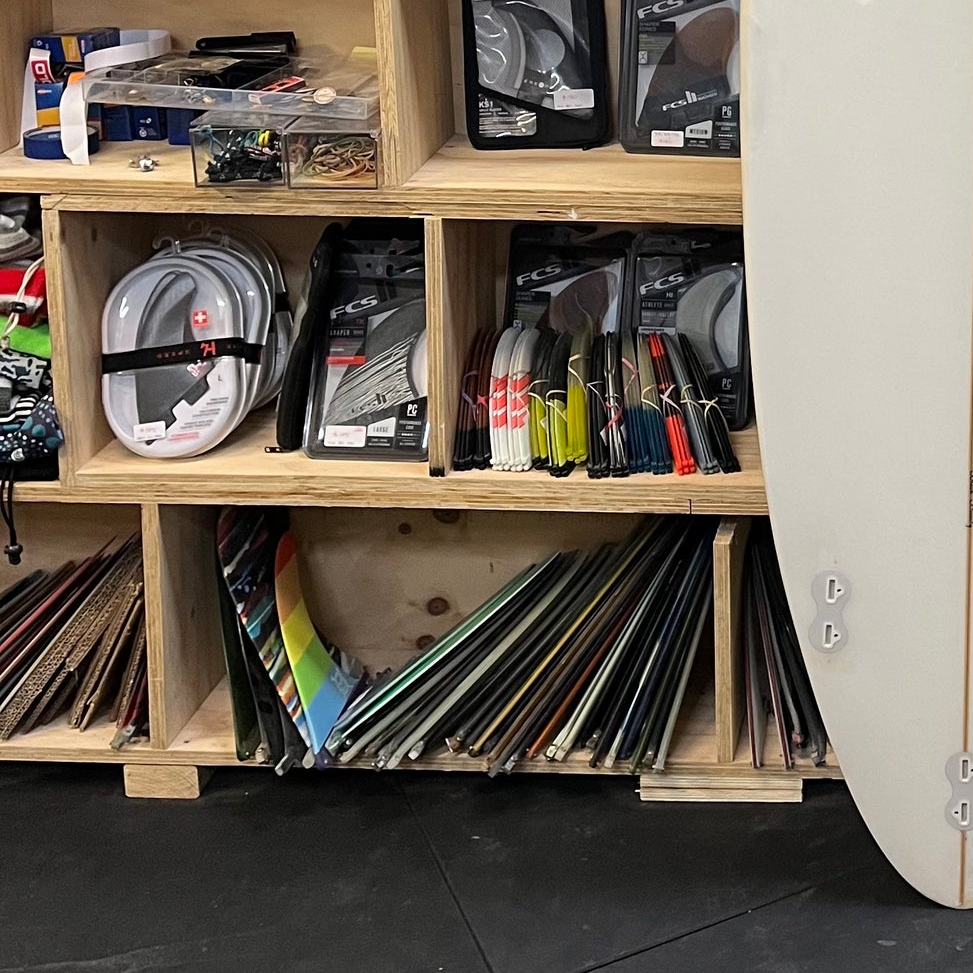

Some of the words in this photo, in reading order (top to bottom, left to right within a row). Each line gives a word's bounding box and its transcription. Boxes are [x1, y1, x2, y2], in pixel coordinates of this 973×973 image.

[517, 263, 561, 286] FCS
[639, 272, 684, 295] FCS
[330, 295, 378, 320] FCS
[407, 403, 418, 414] PC
